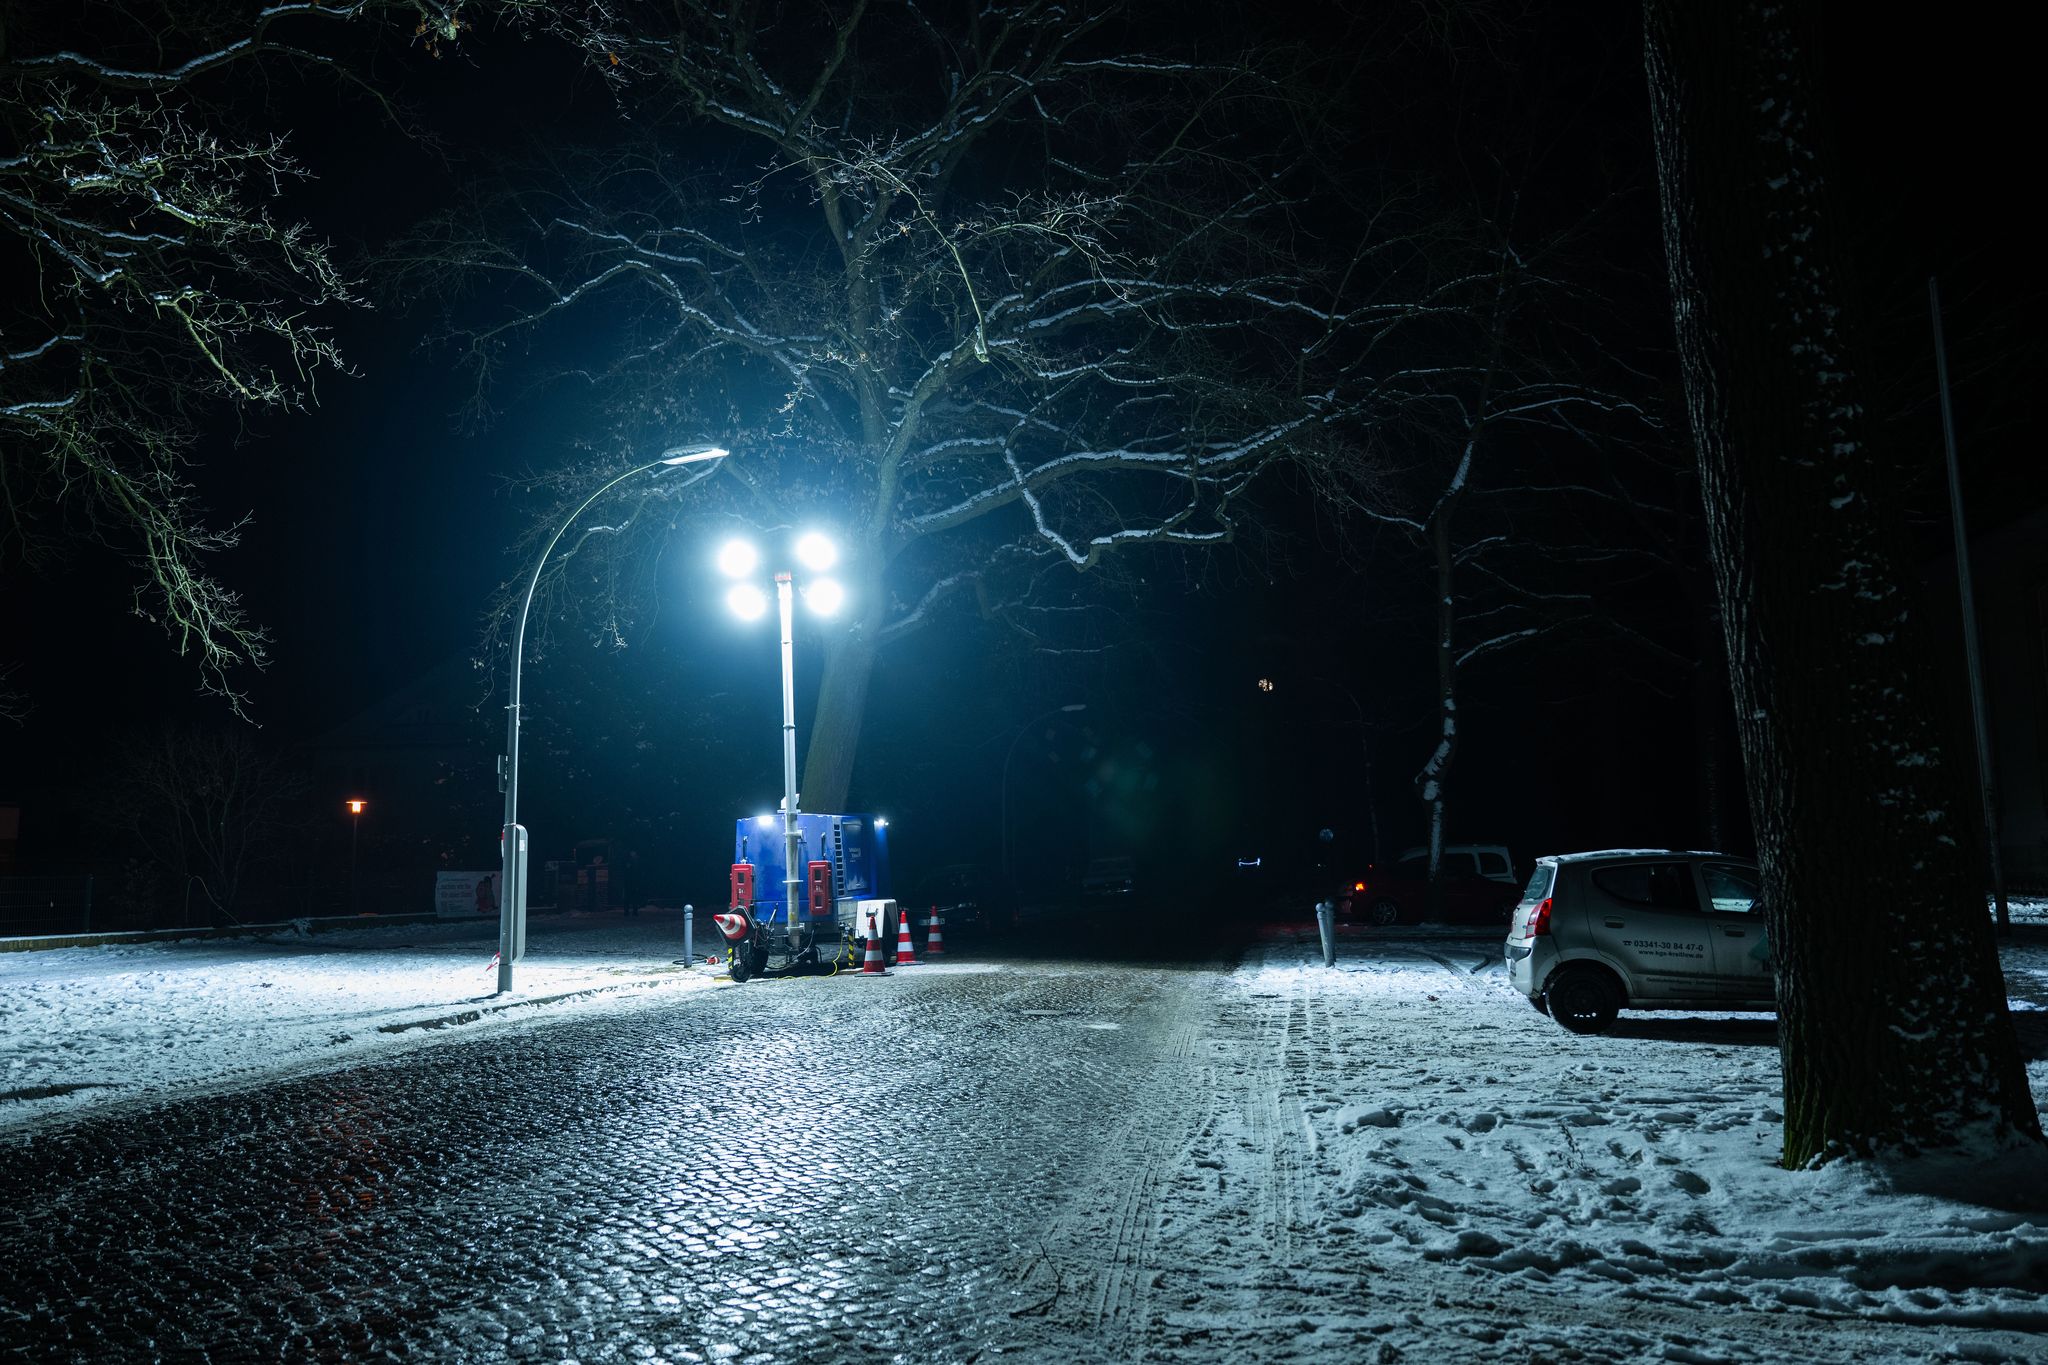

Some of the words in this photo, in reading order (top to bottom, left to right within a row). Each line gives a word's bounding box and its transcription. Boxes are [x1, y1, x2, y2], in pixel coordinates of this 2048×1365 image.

[1634, 940, 1671, 949] 03341-30
[1673, 942, 1683, 950] 84
[1685, 943, 1704, 951] 47-0
